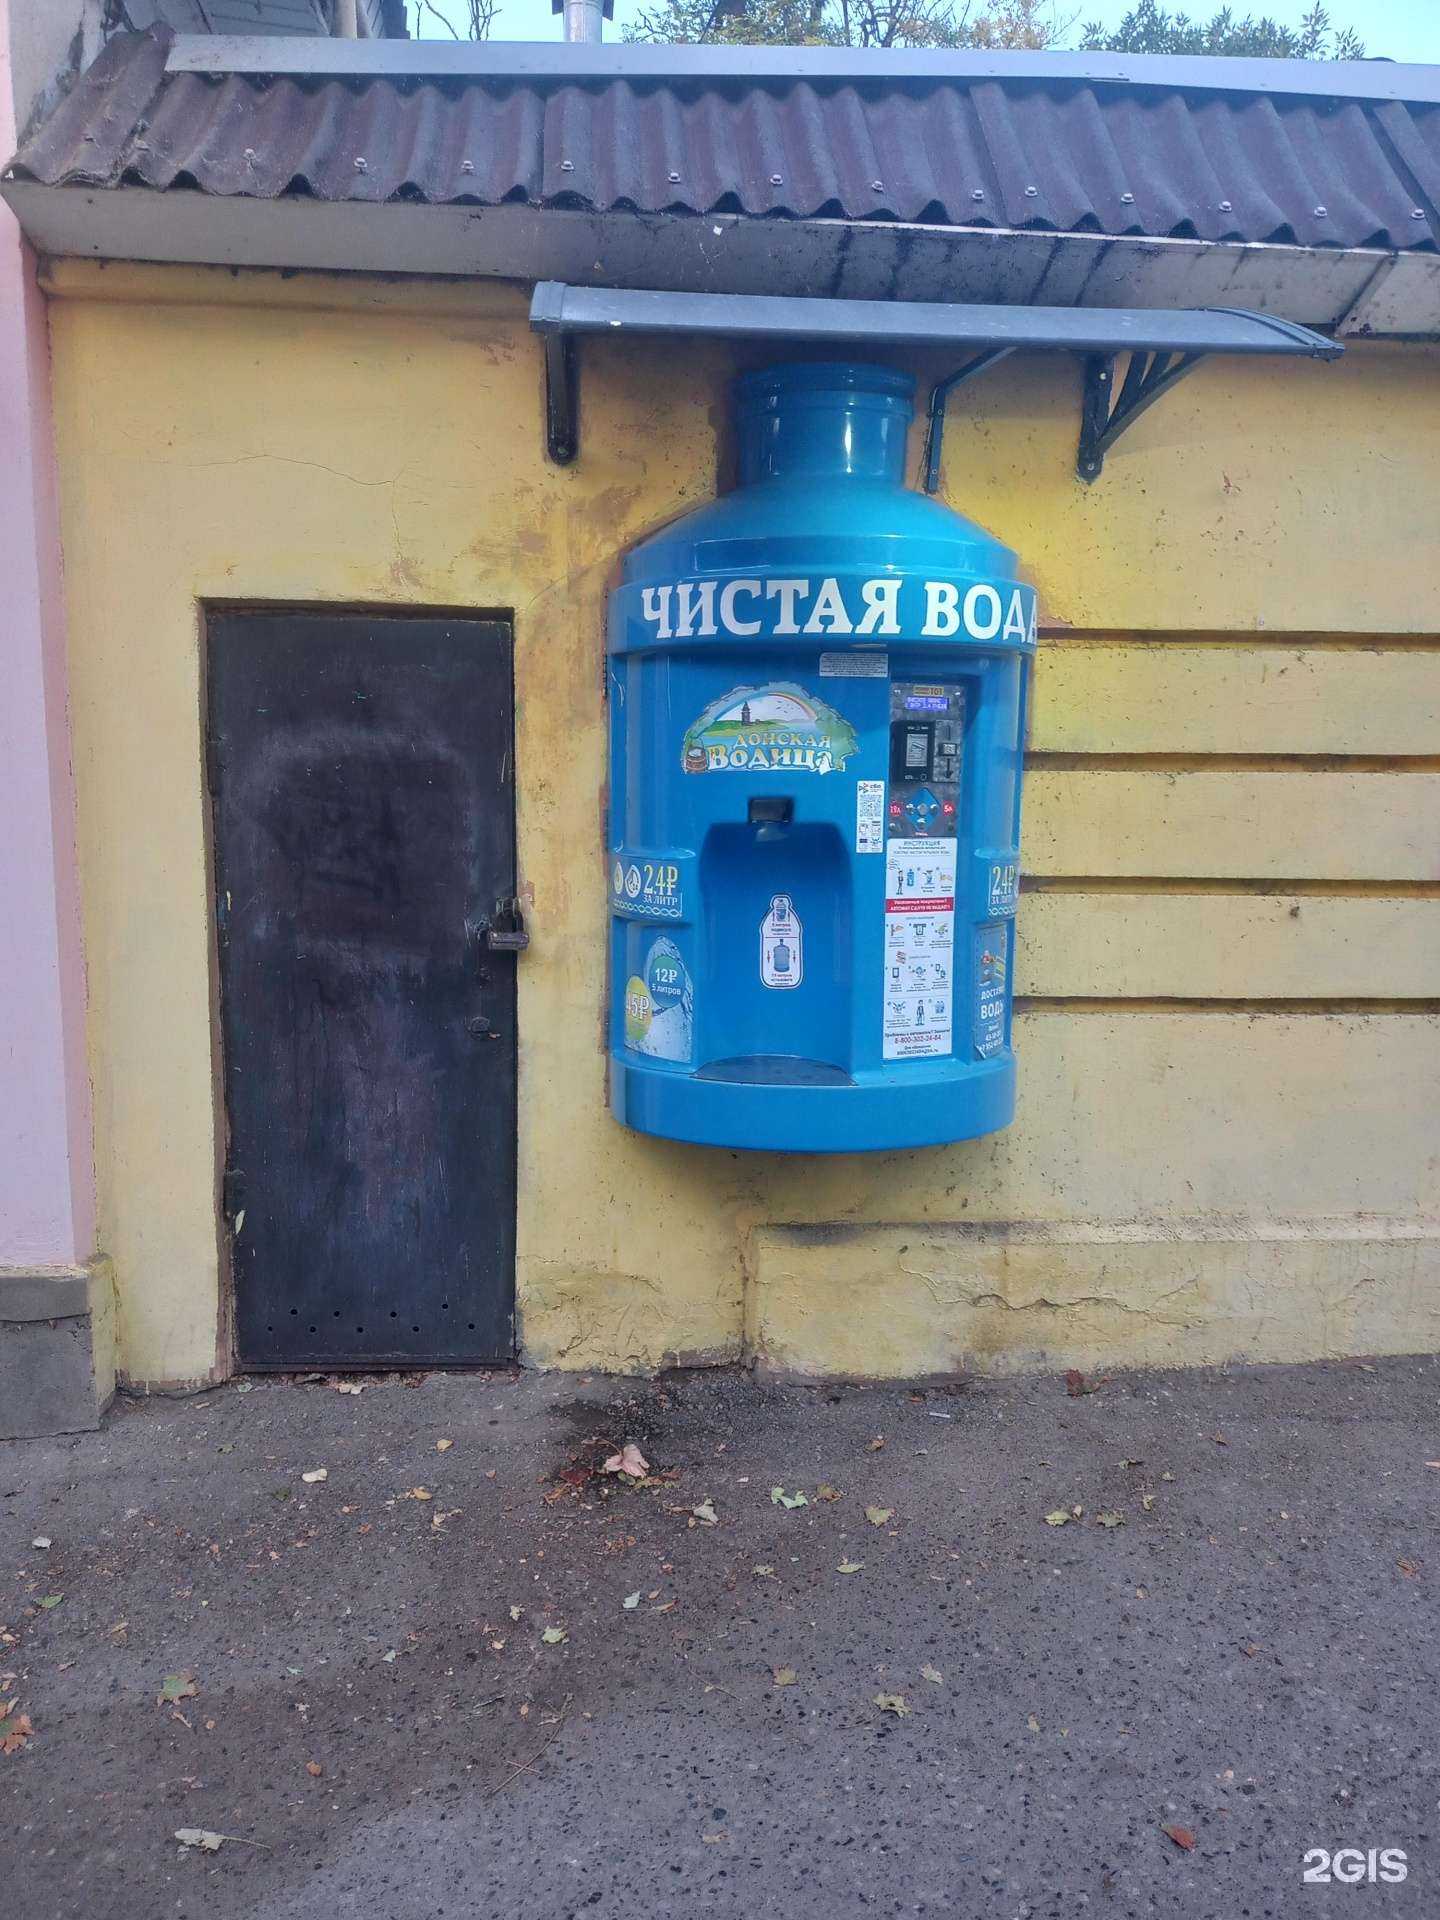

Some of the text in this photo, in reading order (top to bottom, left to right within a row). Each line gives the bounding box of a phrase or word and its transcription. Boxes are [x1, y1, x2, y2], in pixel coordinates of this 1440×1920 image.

[641, 578, 903, 638] ЧИСТАЯ
[733, 732, 831, 748] ДОНСКАЯ
[654, 895, 678, 906] ЛИТР
[651, 983, 681, 995] 5 литров
